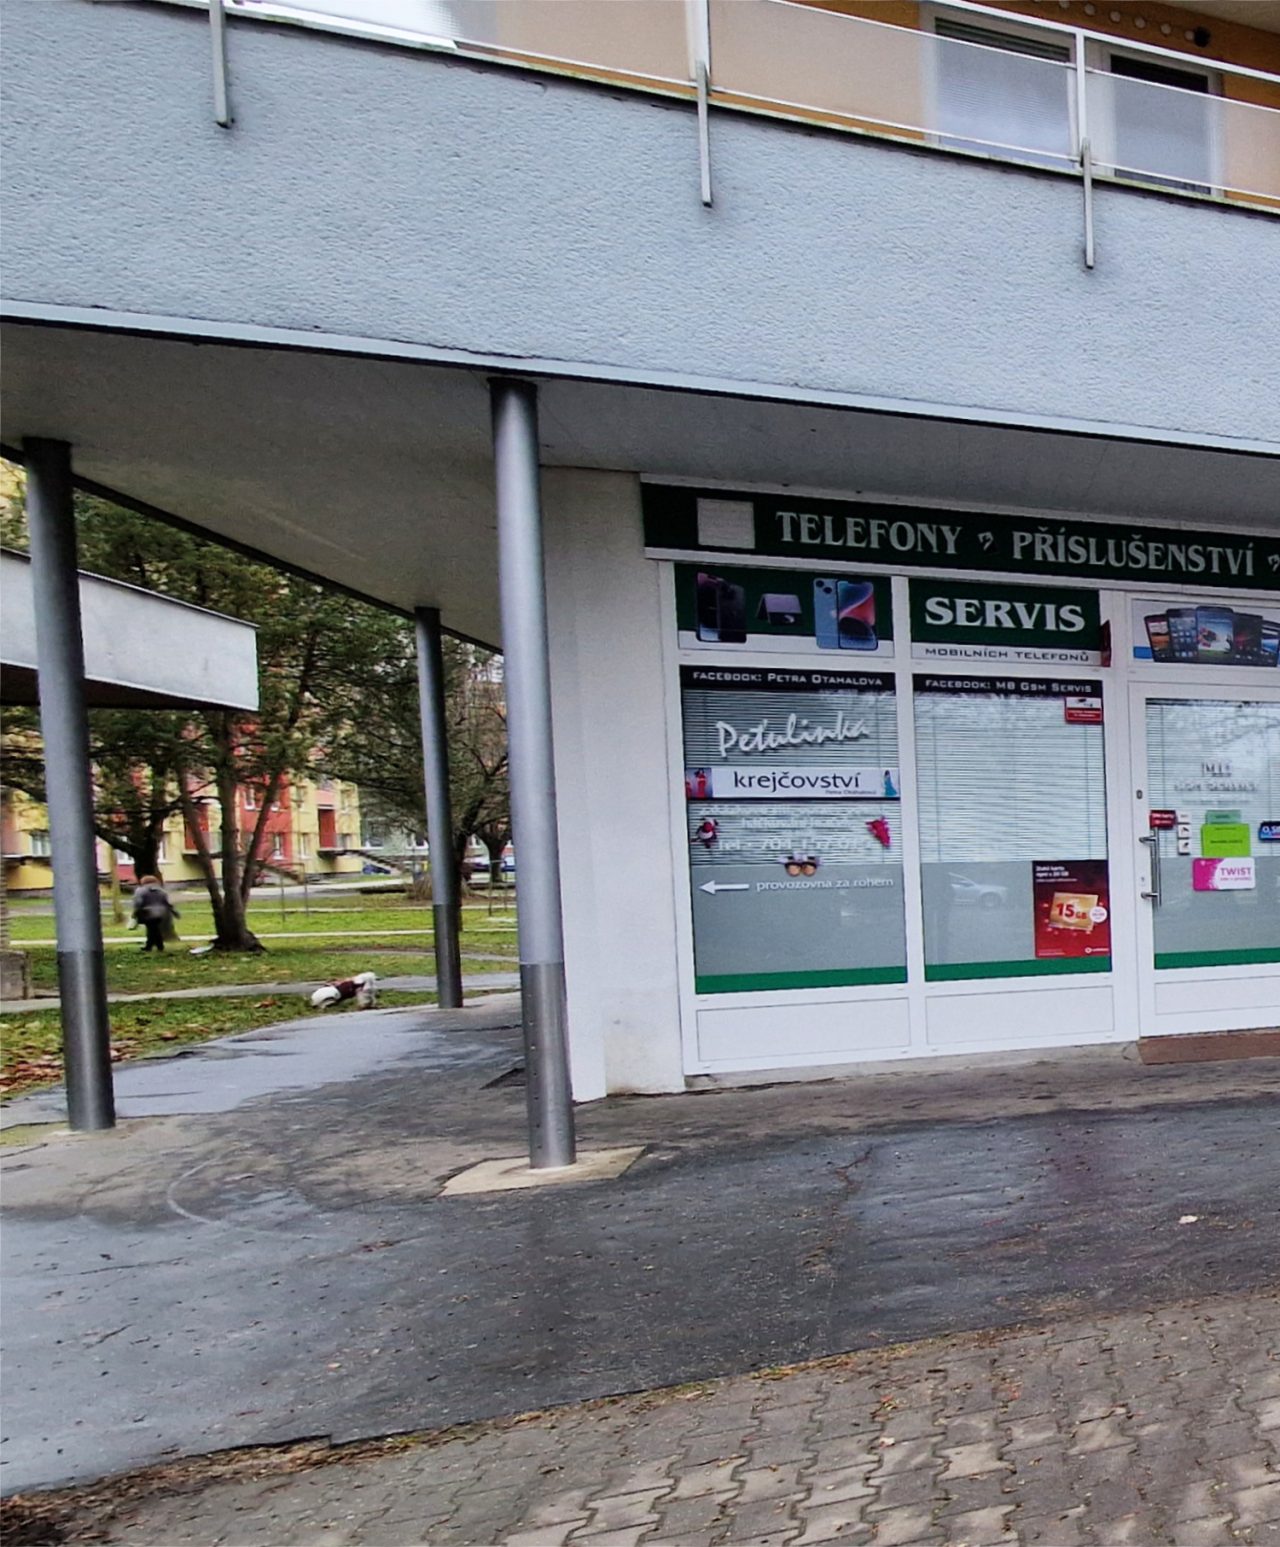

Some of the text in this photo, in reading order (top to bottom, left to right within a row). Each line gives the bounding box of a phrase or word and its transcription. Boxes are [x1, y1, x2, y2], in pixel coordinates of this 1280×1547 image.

[775, 512, 962, 555] TELEFONY
[1012, 526, 1255, 576] PŘÍSLUŠENSTVÍ
[925, 597, 1085, 632] SERVIS
[925, 647, 1090, 662] MOBILNÍCH TELEFONŮ
[693, 672, 762, 682] FACEBOOK:
[995, 681, 1016, 690] MB
[733, 771, 862, 793] krejčovství
[1220, 867, 1252, 876] TWIST
[756, 877, 894, 892] provozovna za rohem
[1055, 902, 1075, 918] 15
